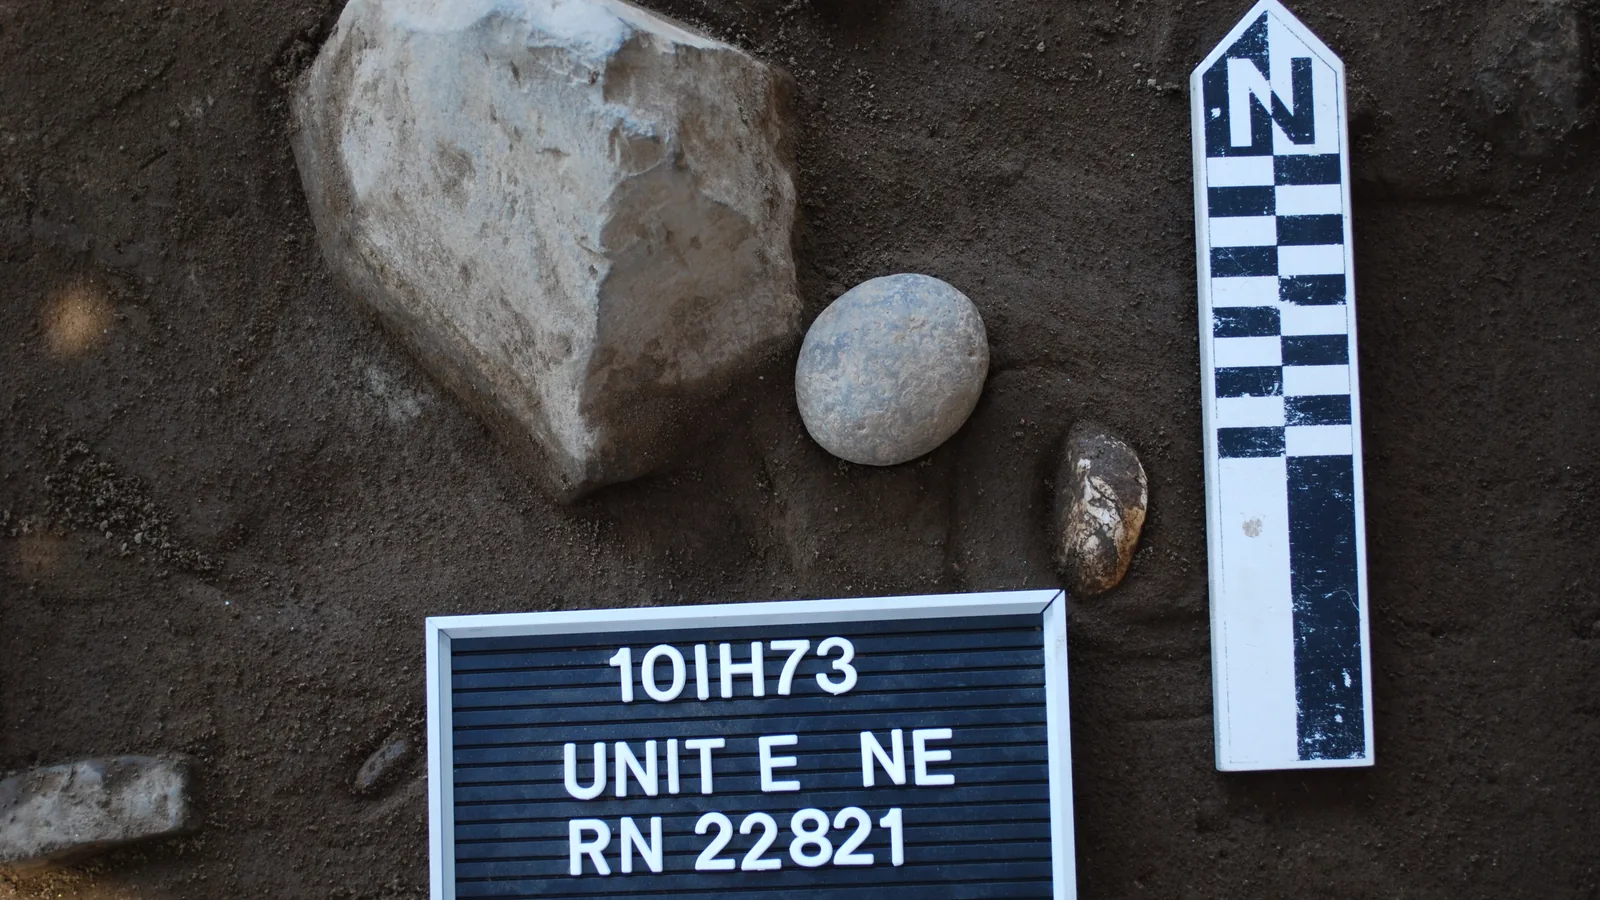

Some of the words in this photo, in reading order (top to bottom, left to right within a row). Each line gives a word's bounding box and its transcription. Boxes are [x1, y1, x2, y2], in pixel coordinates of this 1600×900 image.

[1226, 57, 1316, 148] N
[563, 737, 727, 801] UNIT
[758, 734, 802, 793] E
[859, 727, 956, 789] NE
[568, 816, 664, 877] RN
[694, 806, 905, 872] 22821
